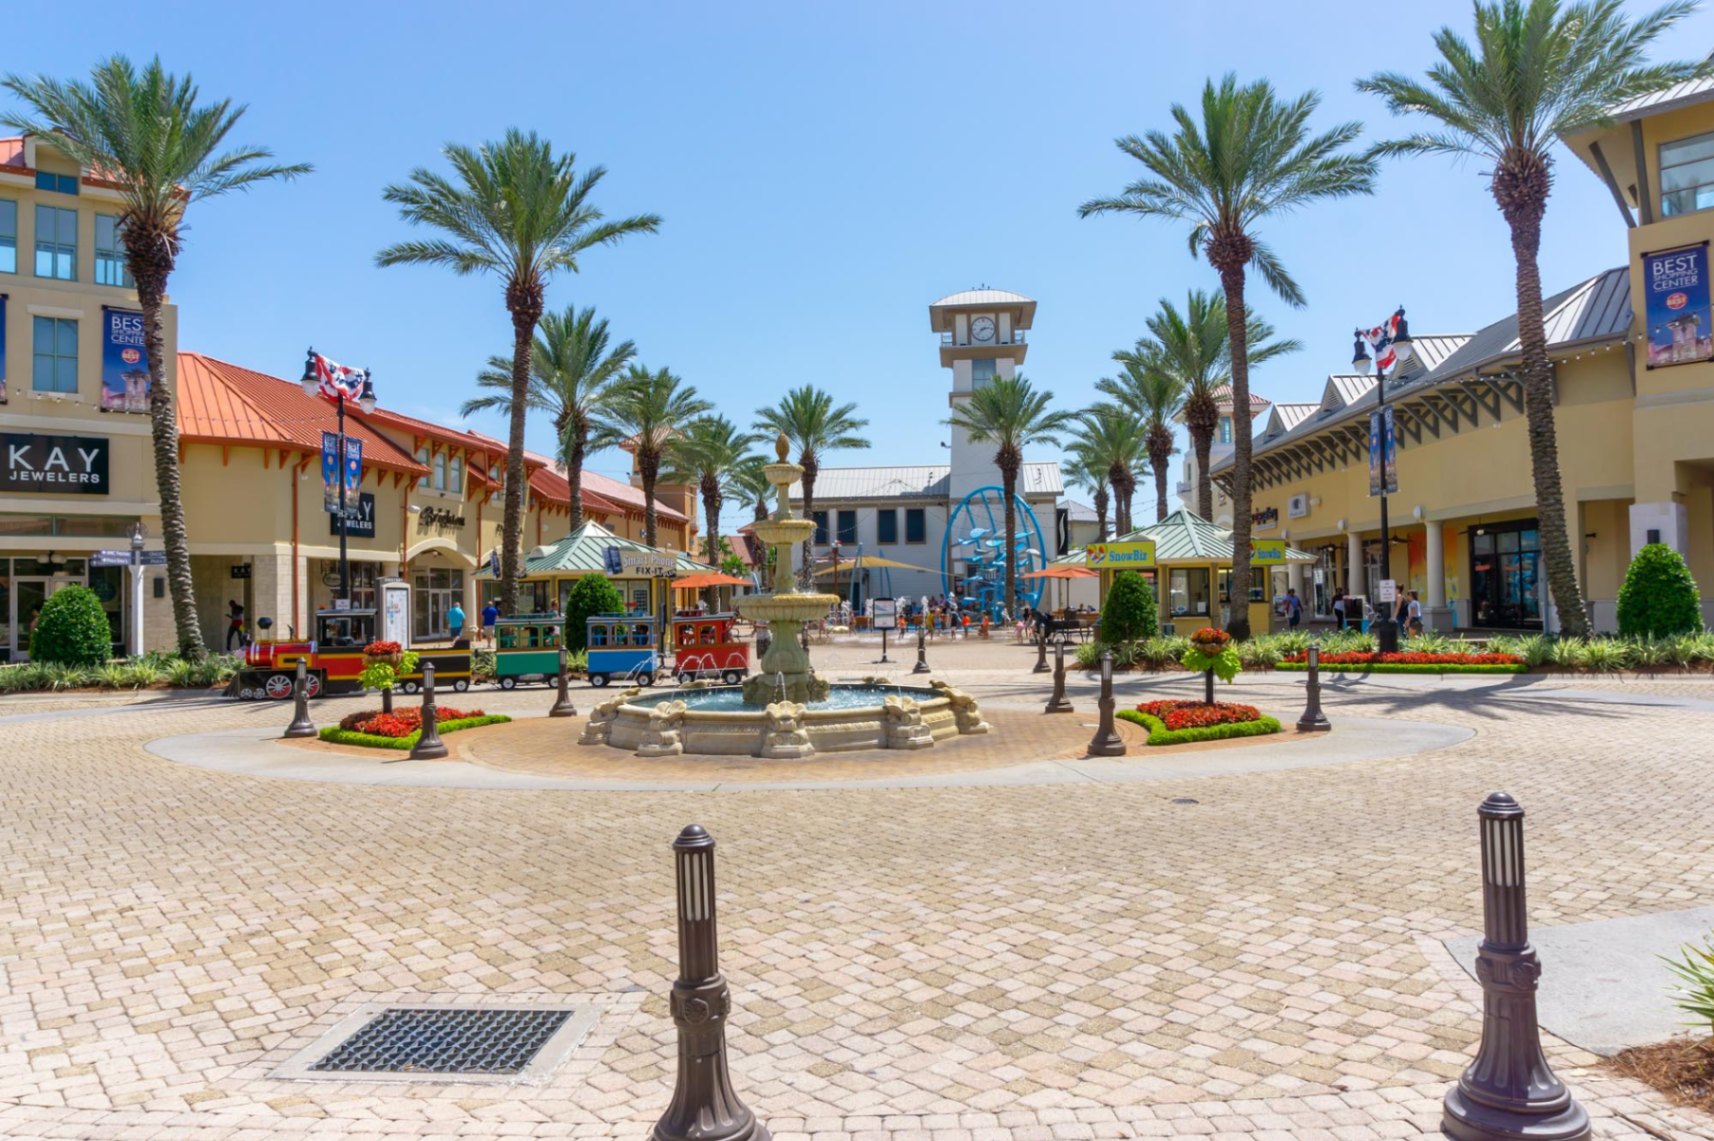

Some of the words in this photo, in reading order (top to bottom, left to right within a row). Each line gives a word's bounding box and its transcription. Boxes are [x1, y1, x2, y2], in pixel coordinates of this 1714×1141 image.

[1652, 254, 1698, 276] BEST
[1652, 275, 1698, 291] CENTER
[111, 316, 144, 332] BES
[111, 335, 145, 345] CENTE
[9, 444, 99, 473] KAY
[9, 470, 100, 484] JEWELERS
[623, 554, 648, 568] Smart
[651, 553, 675, 568] Phone
[1109, 549, 1148, 562] SnowBiz
[635, 566, 664, 575] FIX-IT
